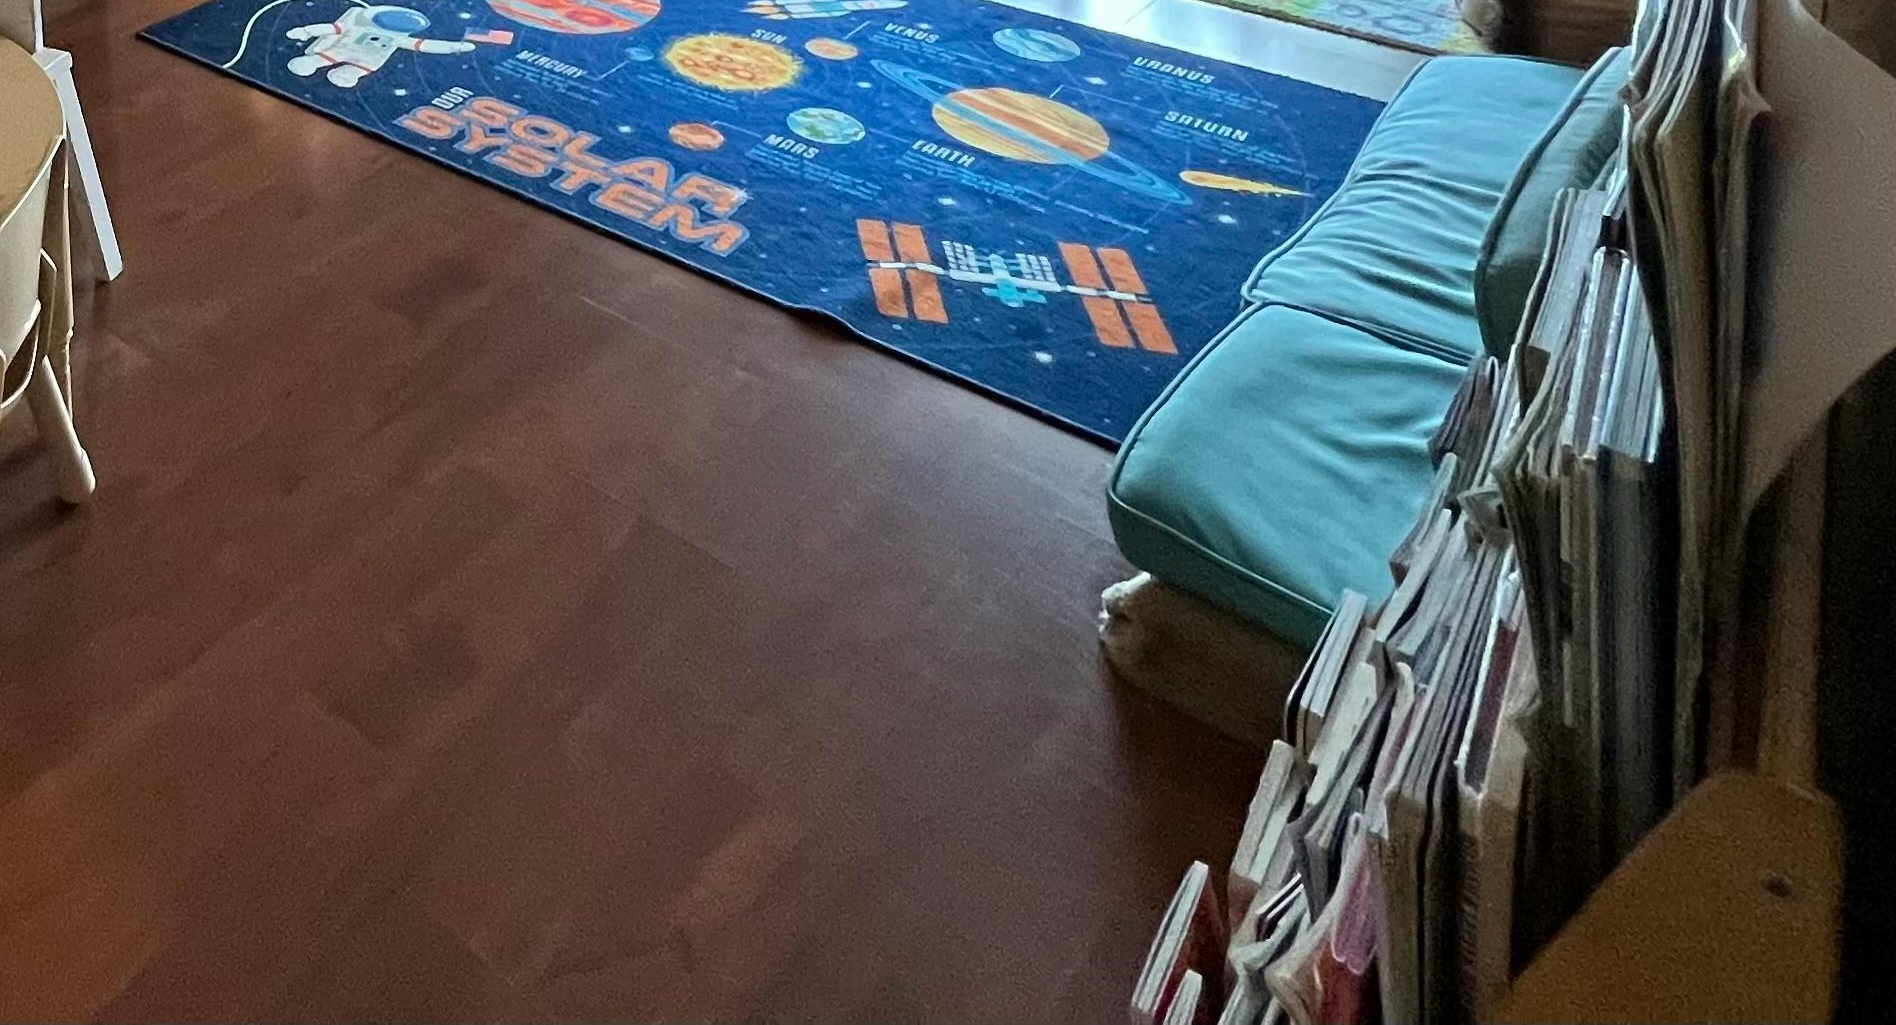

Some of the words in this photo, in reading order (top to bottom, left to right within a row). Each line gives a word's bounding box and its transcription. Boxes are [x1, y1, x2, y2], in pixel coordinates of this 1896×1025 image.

[751, 29, 787, 44] SUN
[883, 21, 941, 45] VENUS
[515, 50, 588, 79] MERCURY
[1132, 55, 1215, 86] URANUS
[431, 86, 474, 111] OUR
[1163, 110, 1249, 143] SATURN
[459, 96, 752, 218] SOLAR
[762, 133, 820, 160] MARS
[911, 140, 976, 169] EARTH
[393, 104, 751, 258] SYSTEM
